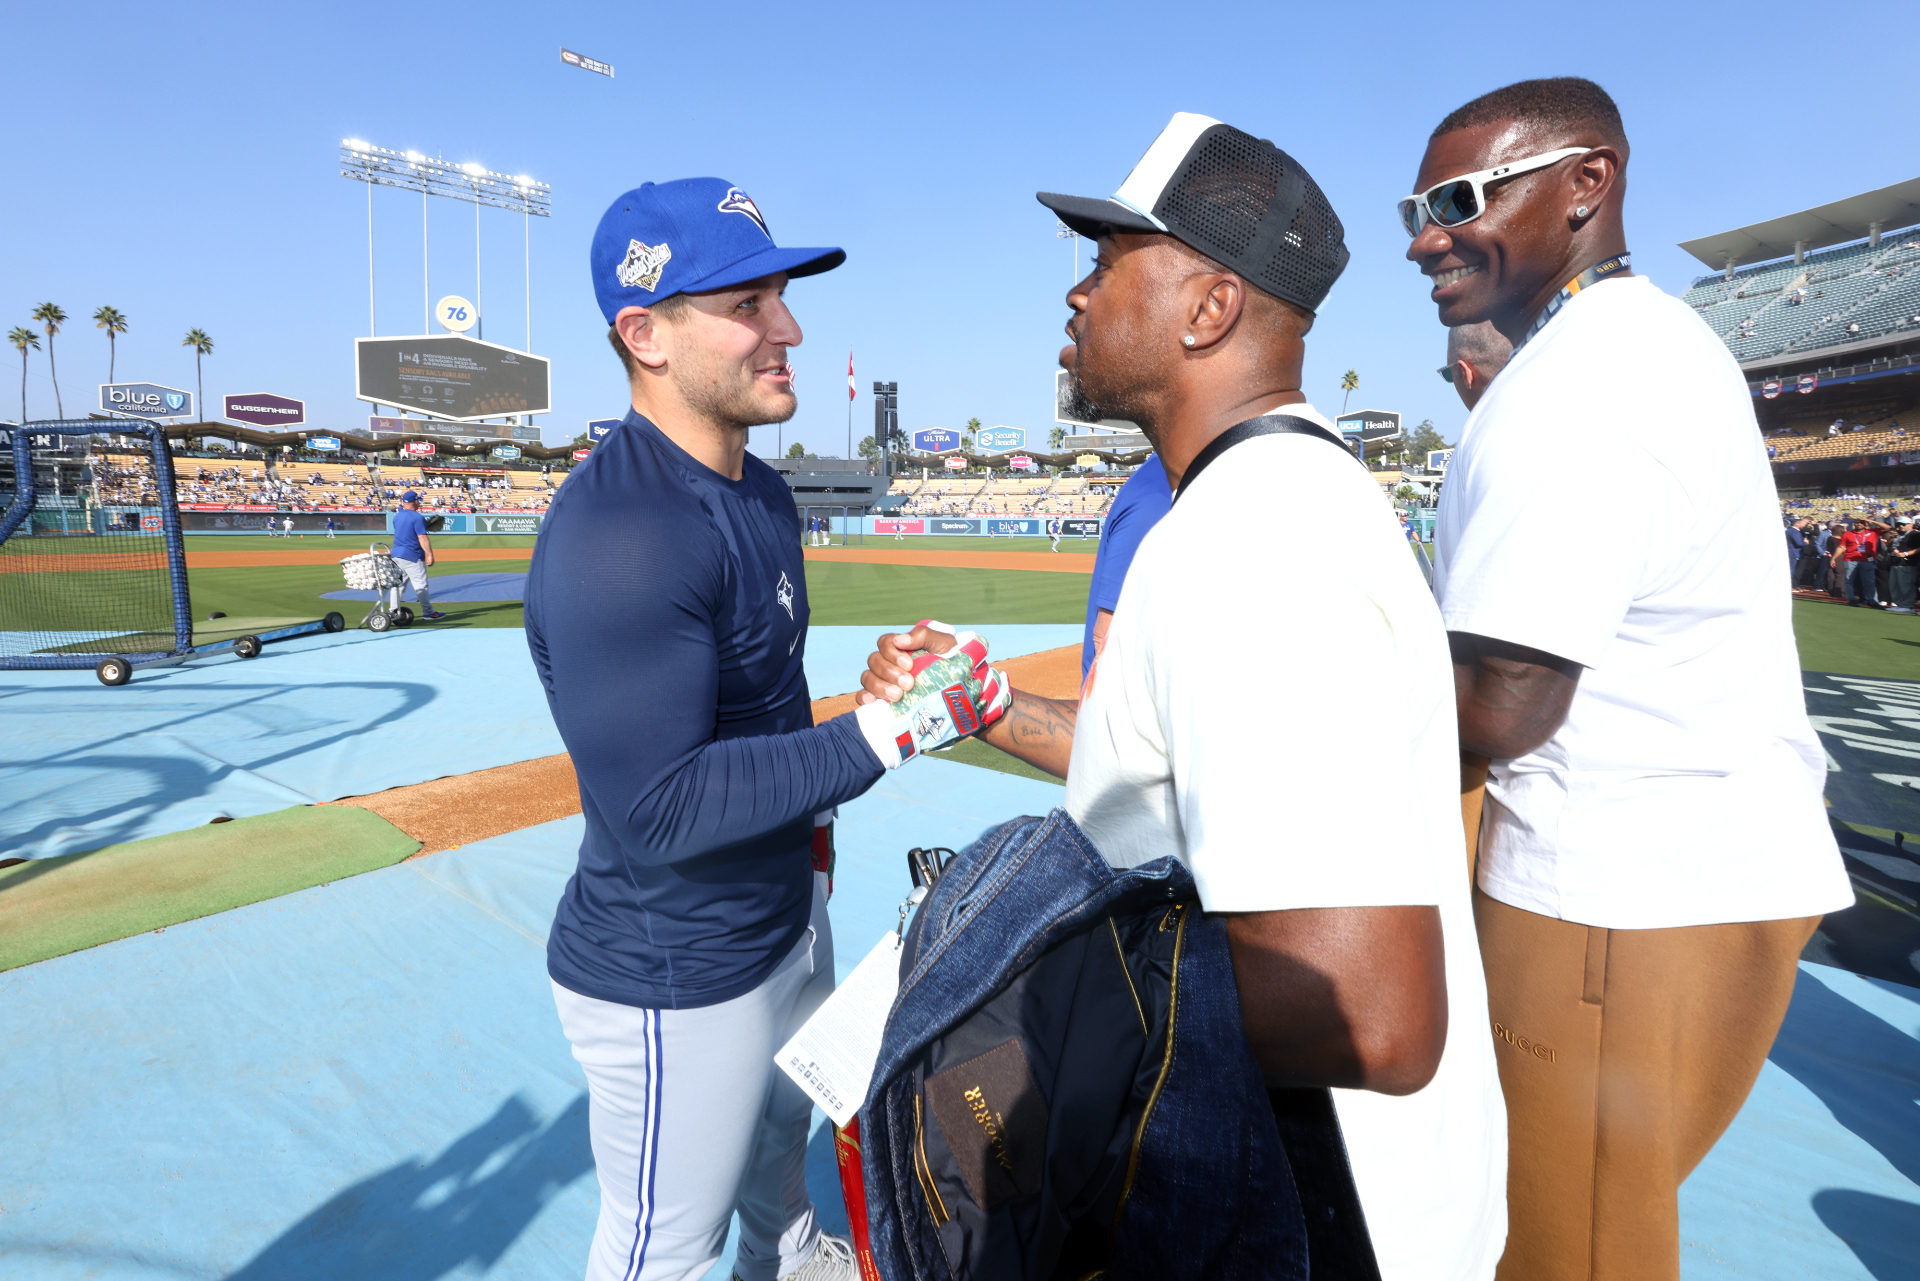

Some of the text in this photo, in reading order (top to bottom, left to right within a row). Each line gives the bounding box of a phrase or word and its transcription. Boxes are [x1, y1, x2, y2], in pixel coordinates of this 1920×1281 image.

[447, 306, 467, 321] 76
[412, 353, 420, 364] 4
[109, 387, 161, 406] blue
[117, 404, 167, 414] california
[231, 404, 299, 415] GUGGENHEIM
[1340, 421, 1360, 430] UCLA
[1365, 420, 1395, 430] Health
[995, 432, 1020, 440] Security
[409, 443, 431, 451] JINRO
[145, 518, 159, 528] 76
[942, 522, 968, 531] Spectrum
[945, 689, 973, 732] Franklin
[1494, 1022, 1556, 1064] GUCCI
